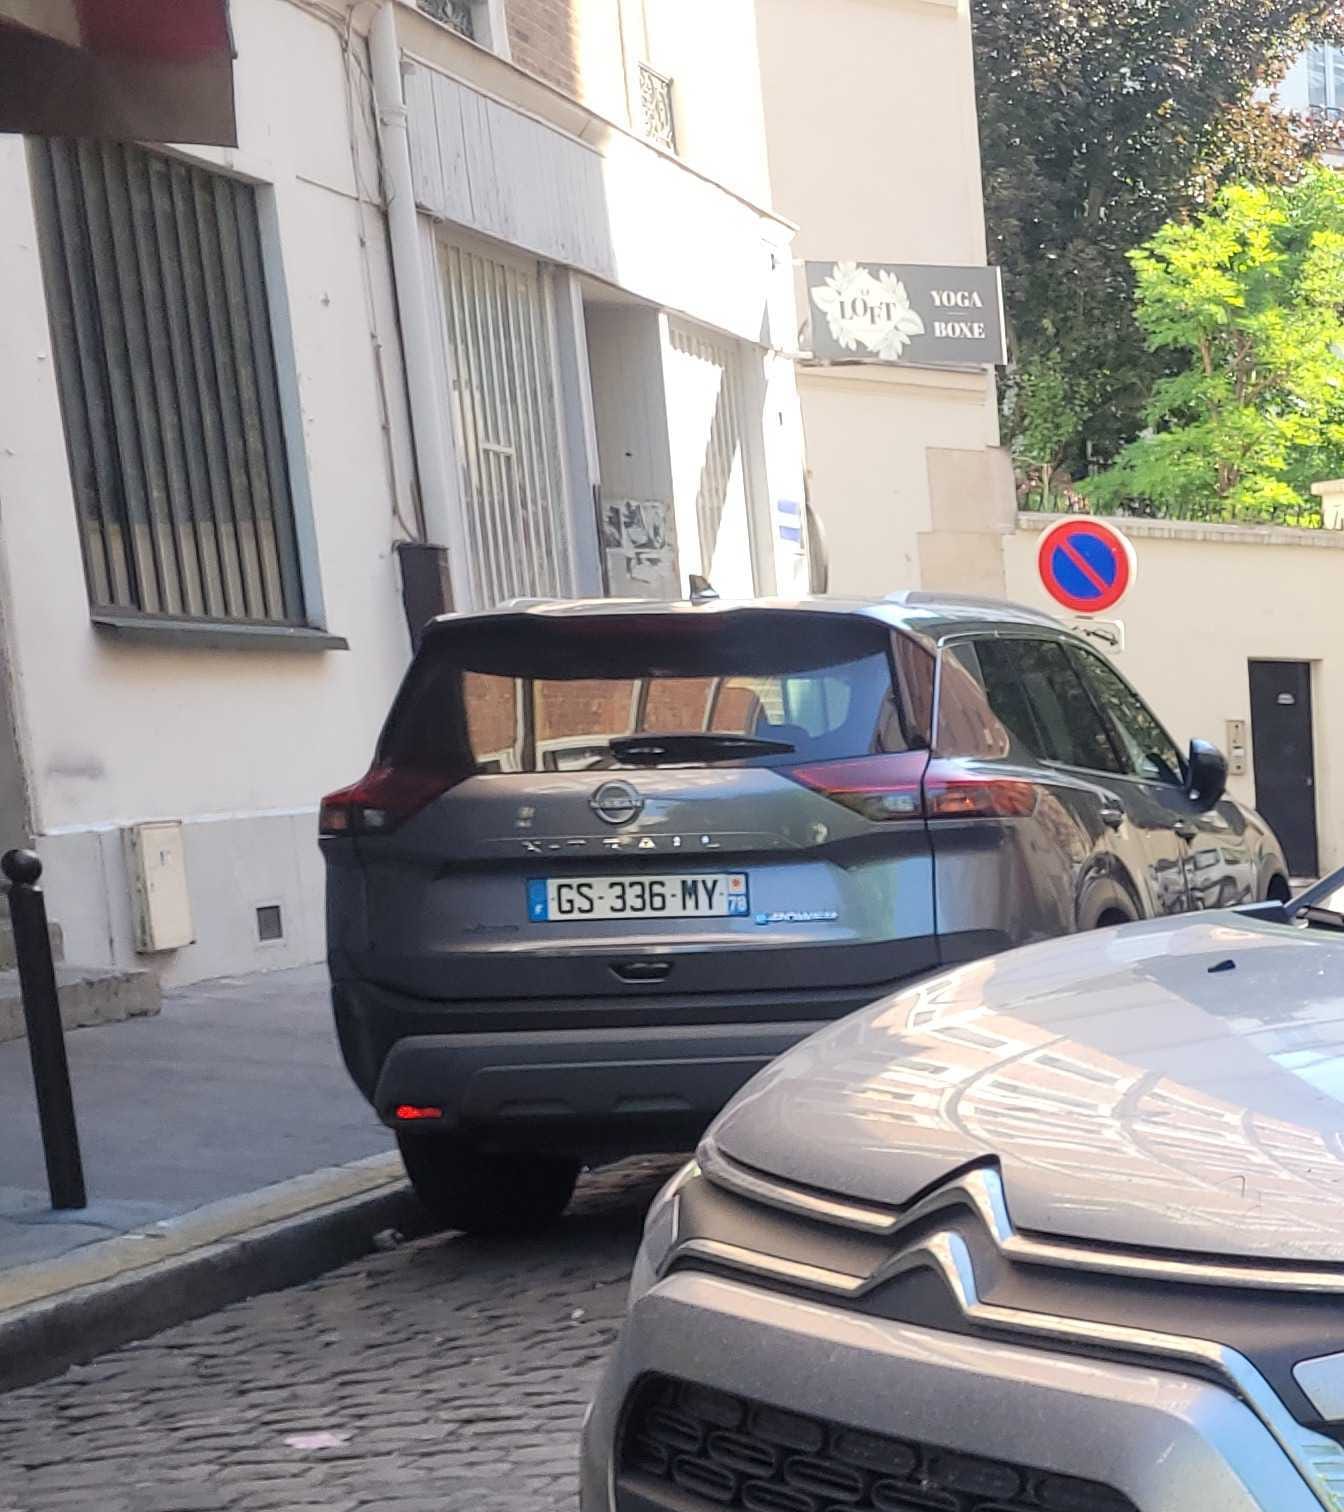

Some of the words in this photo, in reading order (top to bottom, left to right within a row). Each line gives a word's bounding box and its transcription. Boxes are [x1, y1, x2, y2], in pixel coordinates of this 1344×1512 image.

[930, 290, 983, 308] YOGA
[839, 297, 896, 325] LOFT
[933, 322, 985, 339] BOXE
[556, 879, 719, 914] GS-336-MY
